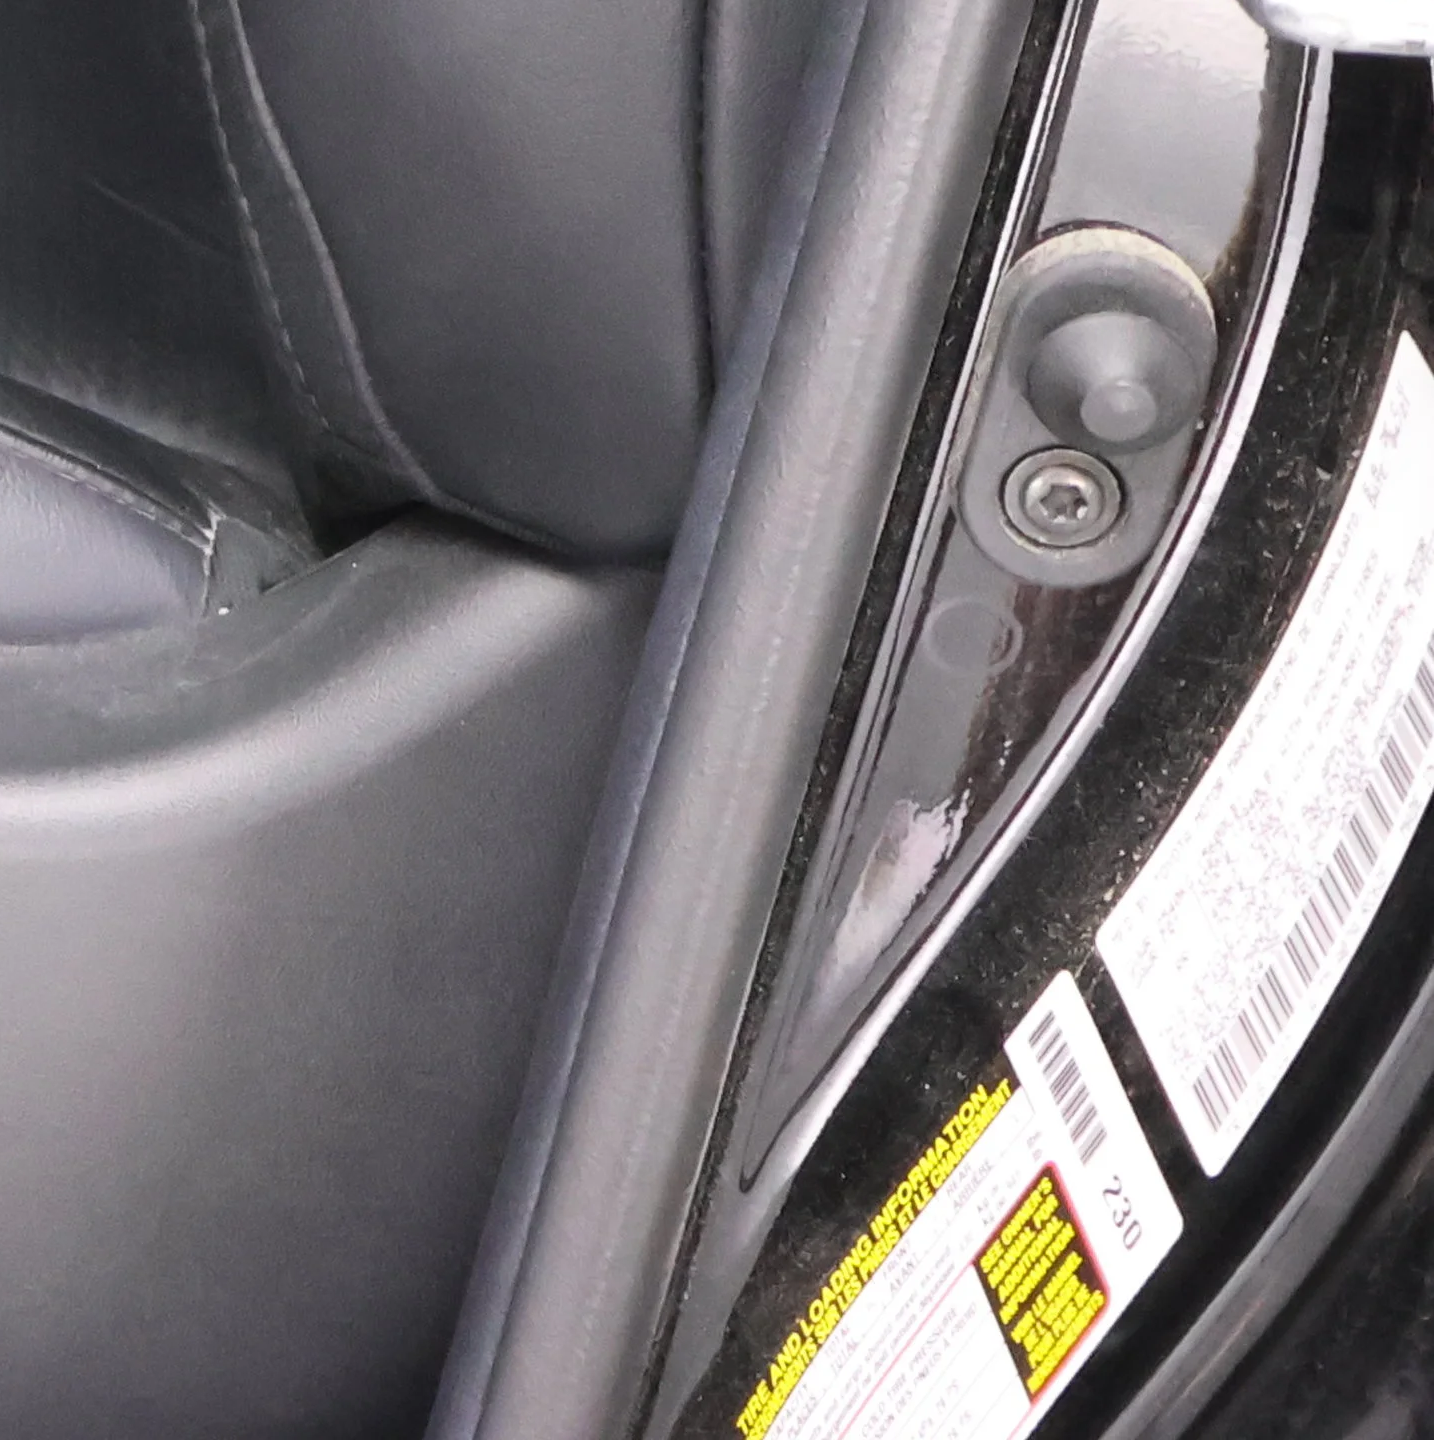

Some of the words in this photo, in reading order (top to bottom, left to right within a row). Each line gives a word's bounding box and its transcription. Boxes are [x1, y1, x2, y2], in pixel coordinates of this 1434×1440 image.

[736, 1378, 773, 1435] TIRE
[772, 1331, 804, 1386] AND
[799, 1233, 874, 1336] LOADING
[868, 1083, 988, 1239] INFORMATION
[812, 1303, 840, 1345] SUR
[836, 1274, 862, 1312] LES
[858, 1223, 900, 1282] PNEUS
[896, 1203, 915, 1232] ET
[913, 1181, 932, 1211] LE
[927, 1077, 1012, 1189] CHARGEMENT
[979, 1238, 1005, 1274] SEE
[999, 1175, 1053, 1246] OWNER'S
[986, 1224, 1035, 1289] MANUAL
[1032, 1192, 1060, 1229] FOR
[998, 1215, 1063, 1303] ADDITIONAL
[1104, 1175, 1142, 1251] 230
[999, 1221, 1076, 1325] INFORMATION
